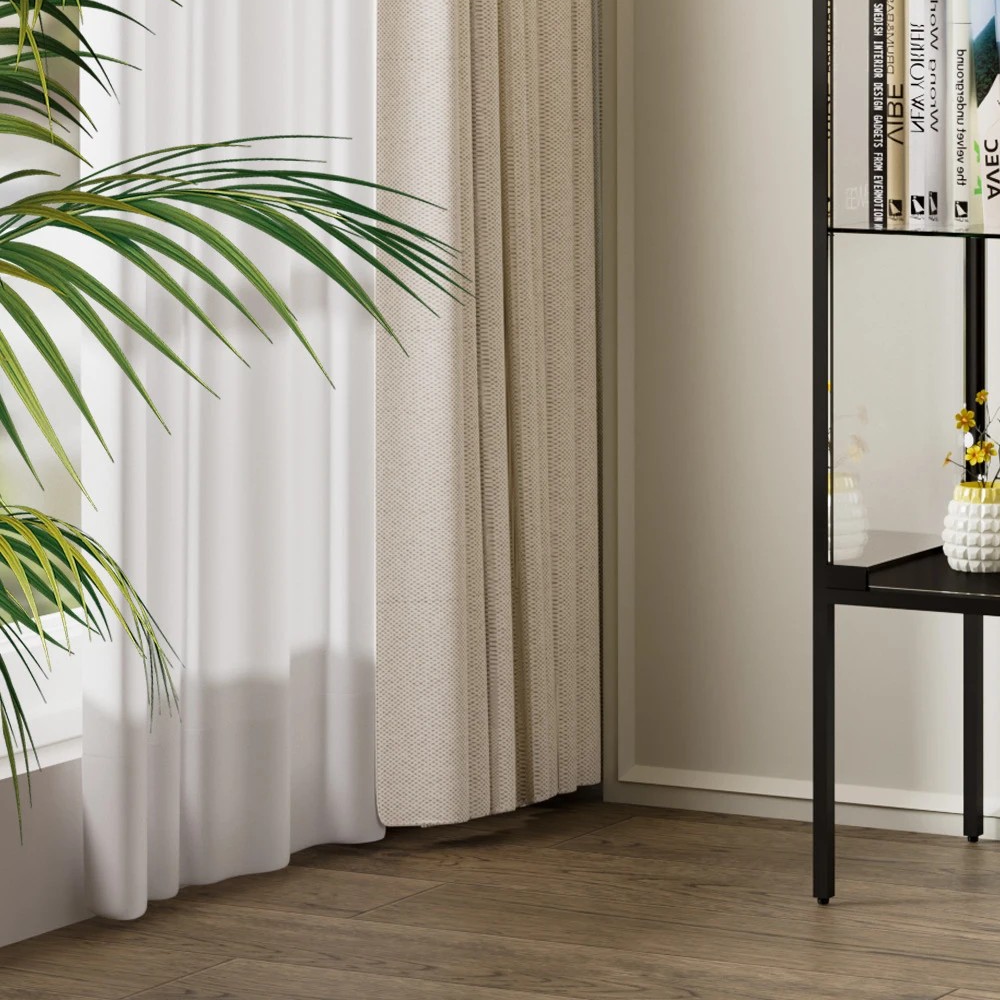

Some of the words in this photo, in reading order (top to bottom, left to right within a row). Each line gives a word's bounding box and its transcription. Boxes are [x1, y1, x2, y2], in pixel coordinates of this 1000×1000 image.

[873, 3, 884, 36] SWEDISH
[873, 41, 884, 78] INTERIOR
[873, 82, 884, 111] DESIGN
[873, 115, 884, 148] GADGETS
[873, 152, 884, 171] FROM
[873, 175, 884, 222] EVERMOTION
